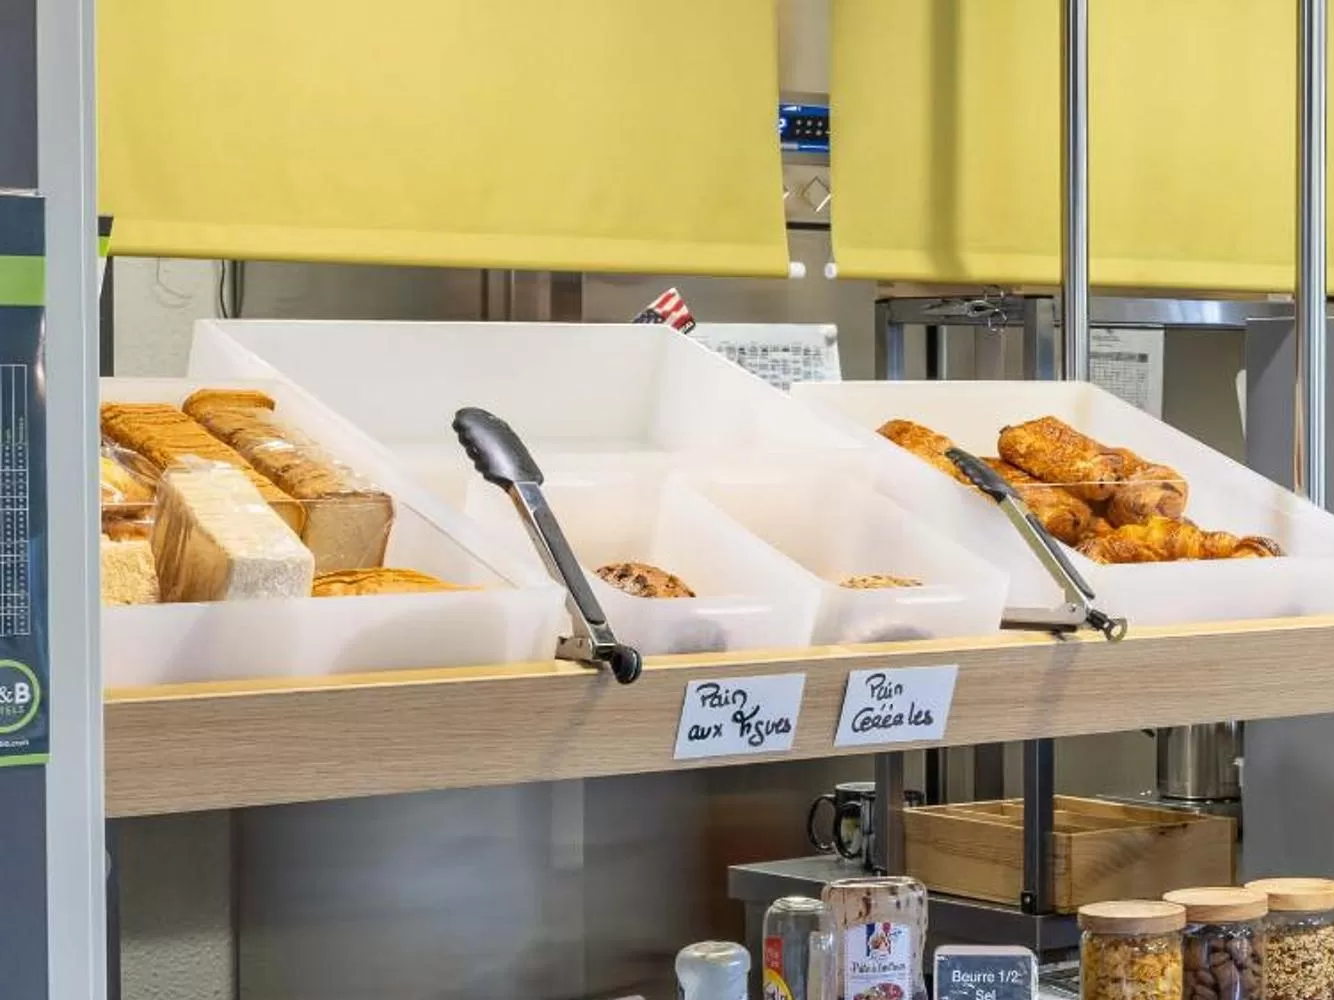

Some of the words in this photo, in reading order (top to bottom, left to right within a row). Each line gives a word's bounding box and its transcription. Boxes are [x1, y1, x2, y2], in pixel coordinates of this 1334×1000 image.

[0, 682, 31, 705] &B
[696, 682, 748, 708] Pain
[865, 673, 904, 700] Pain
[687, 720, 723, 741] aux
[951, 969, 995, 983] Beurre
[998, 969, 1018, 983] 1/2
